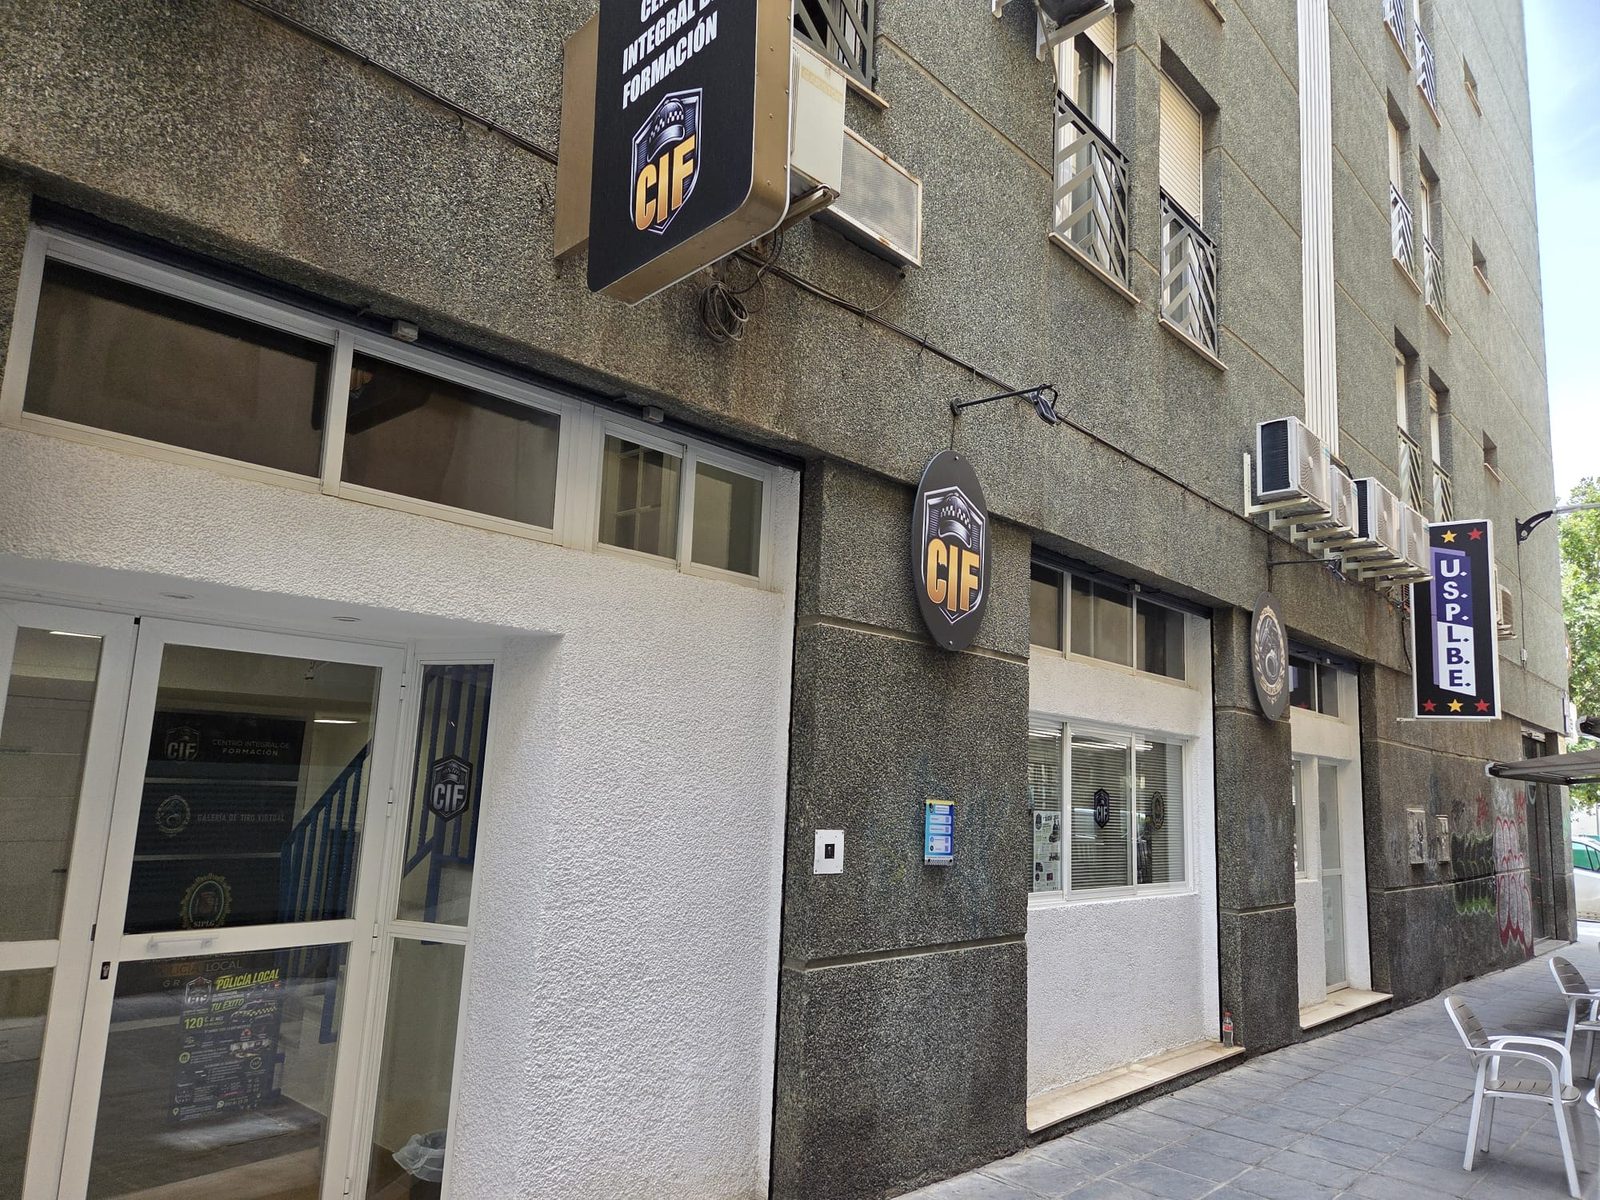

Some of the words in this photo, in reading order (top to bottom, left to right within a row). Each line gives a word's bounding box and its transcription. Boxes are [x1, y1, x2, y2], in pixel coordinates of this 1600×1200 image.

[622, 0, 696, 75] INTEGRAL
[622, 10, 718, 110] FORMACIÓN
[635, 134, 696, 231] CIF
[926, 538, 980, 612] CIF
[167, 742, 197, 760] CIF
[433, 783, 465, 812] CIF
[1097, 806, 1109, 822] CIF
[206, 960, 242, 972] LOCAL
[215, 973, 251, 990] POLICÍA
[252, 967, 280, 983] LOCAL
[184, 1016, 204, 1029] 120
